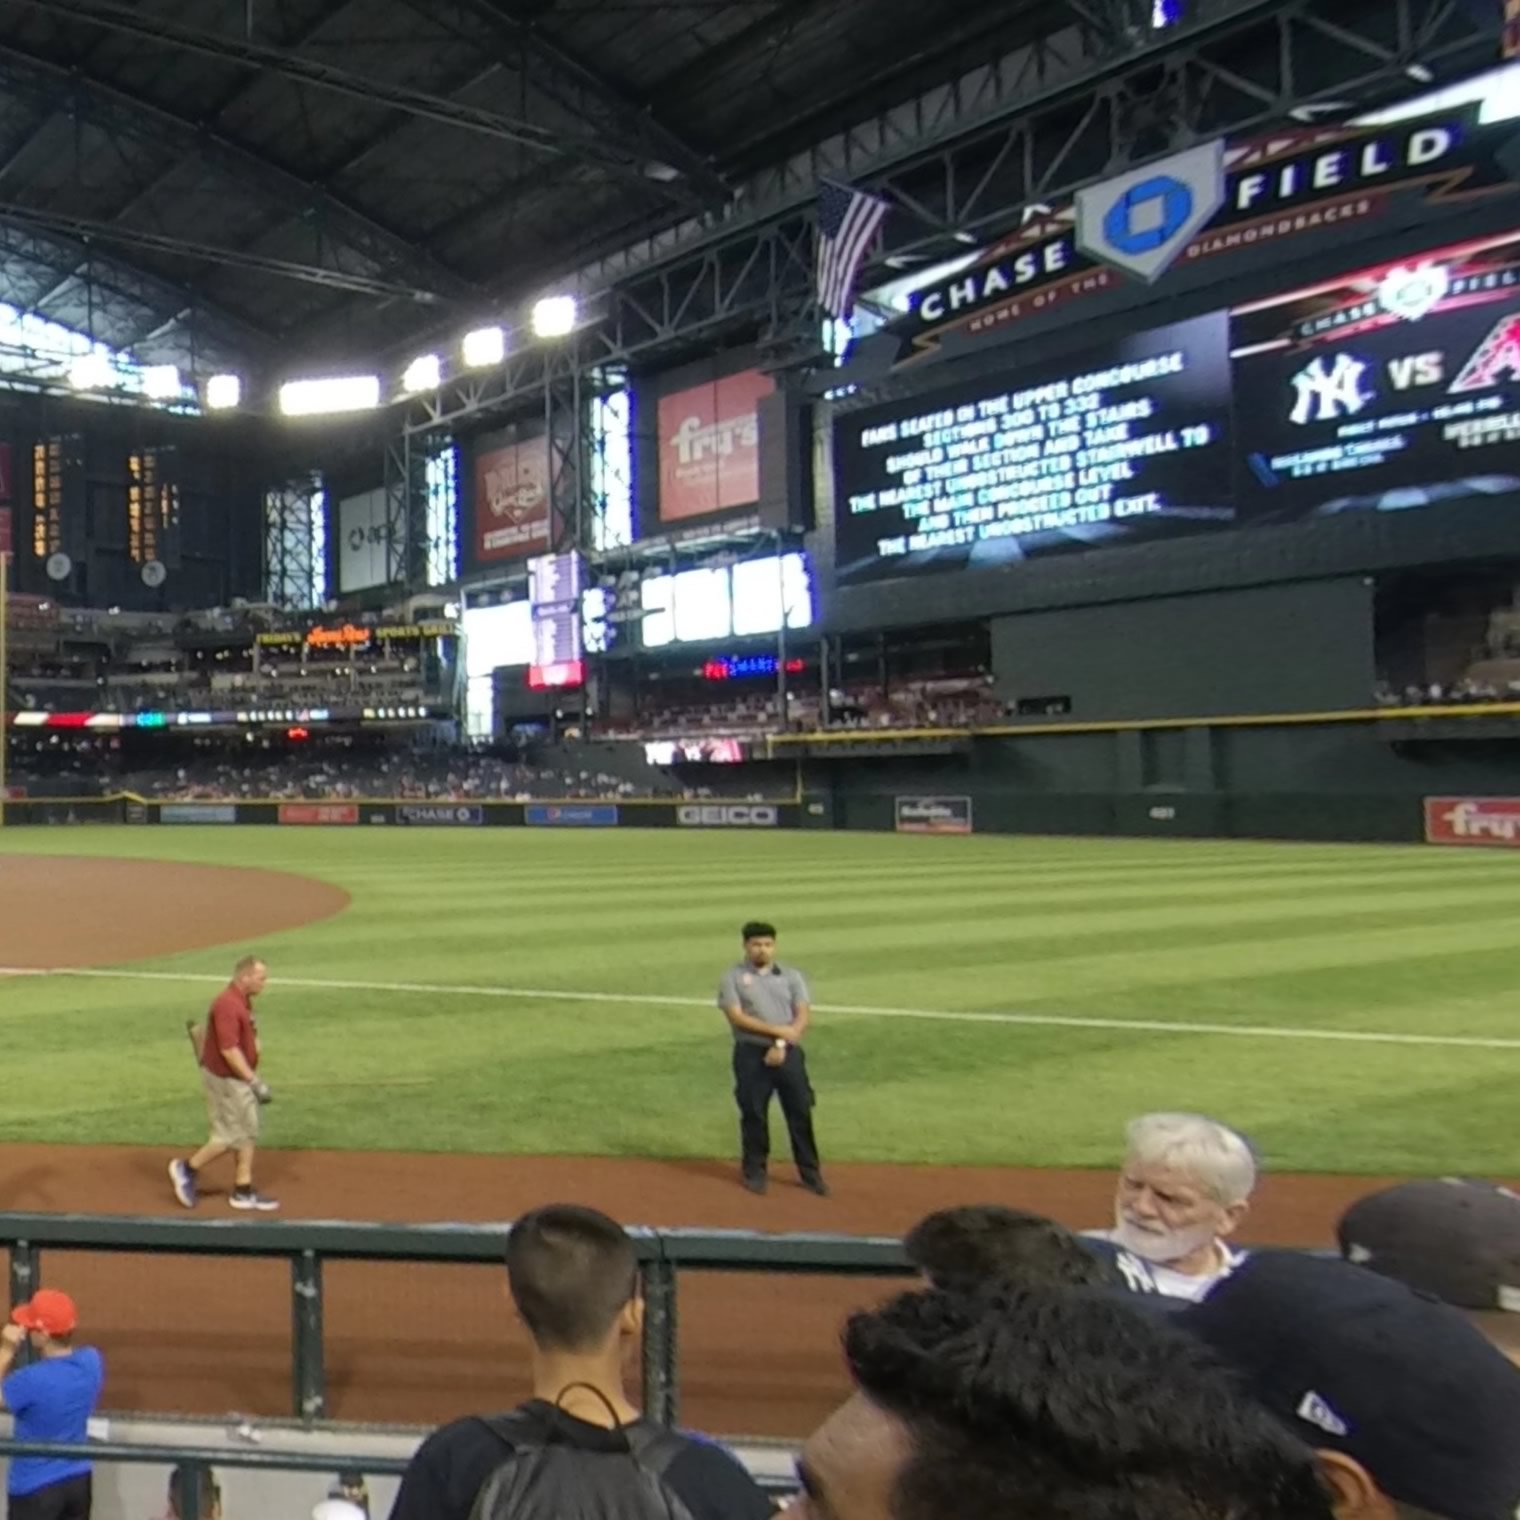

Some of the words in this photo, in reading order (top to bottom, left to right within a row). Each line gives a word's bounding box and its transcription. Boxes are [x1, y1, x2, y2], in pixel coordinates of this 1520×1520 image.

[920, 241, 1067, 322] CHASE
[1238, 127, 1451, 210] FIELD
[970, 305, 1021, 332] HOME
[1034, 289, 1057, 307] OF
[1070, 273, 1110, 296] THE
[1187, 202, 1371, 259] DIAMONDBACKS
[979, 397, 1008, 417] THE
[1013, 382, 1068, 409] UPPER
[1072, 352, 1182, 392] CONCOURSE
[1388, 352, 1444, 389] VS
[1038, 403, 1060, 420] TO
[1049, 415, 1080, 436] THE
[1086, 399, 1153, 426] STAIRS
[1044, 435, 1080, 454] AND
[849, 493, 876, 513] THE
[1181, 425, 1209, 447] TO
[1075, 484, 1112, 504] OUT
[902, 501, 930, 519] THE
[878, 537, 906, 556] THE
[680, 804, 776, 825] GEICO
